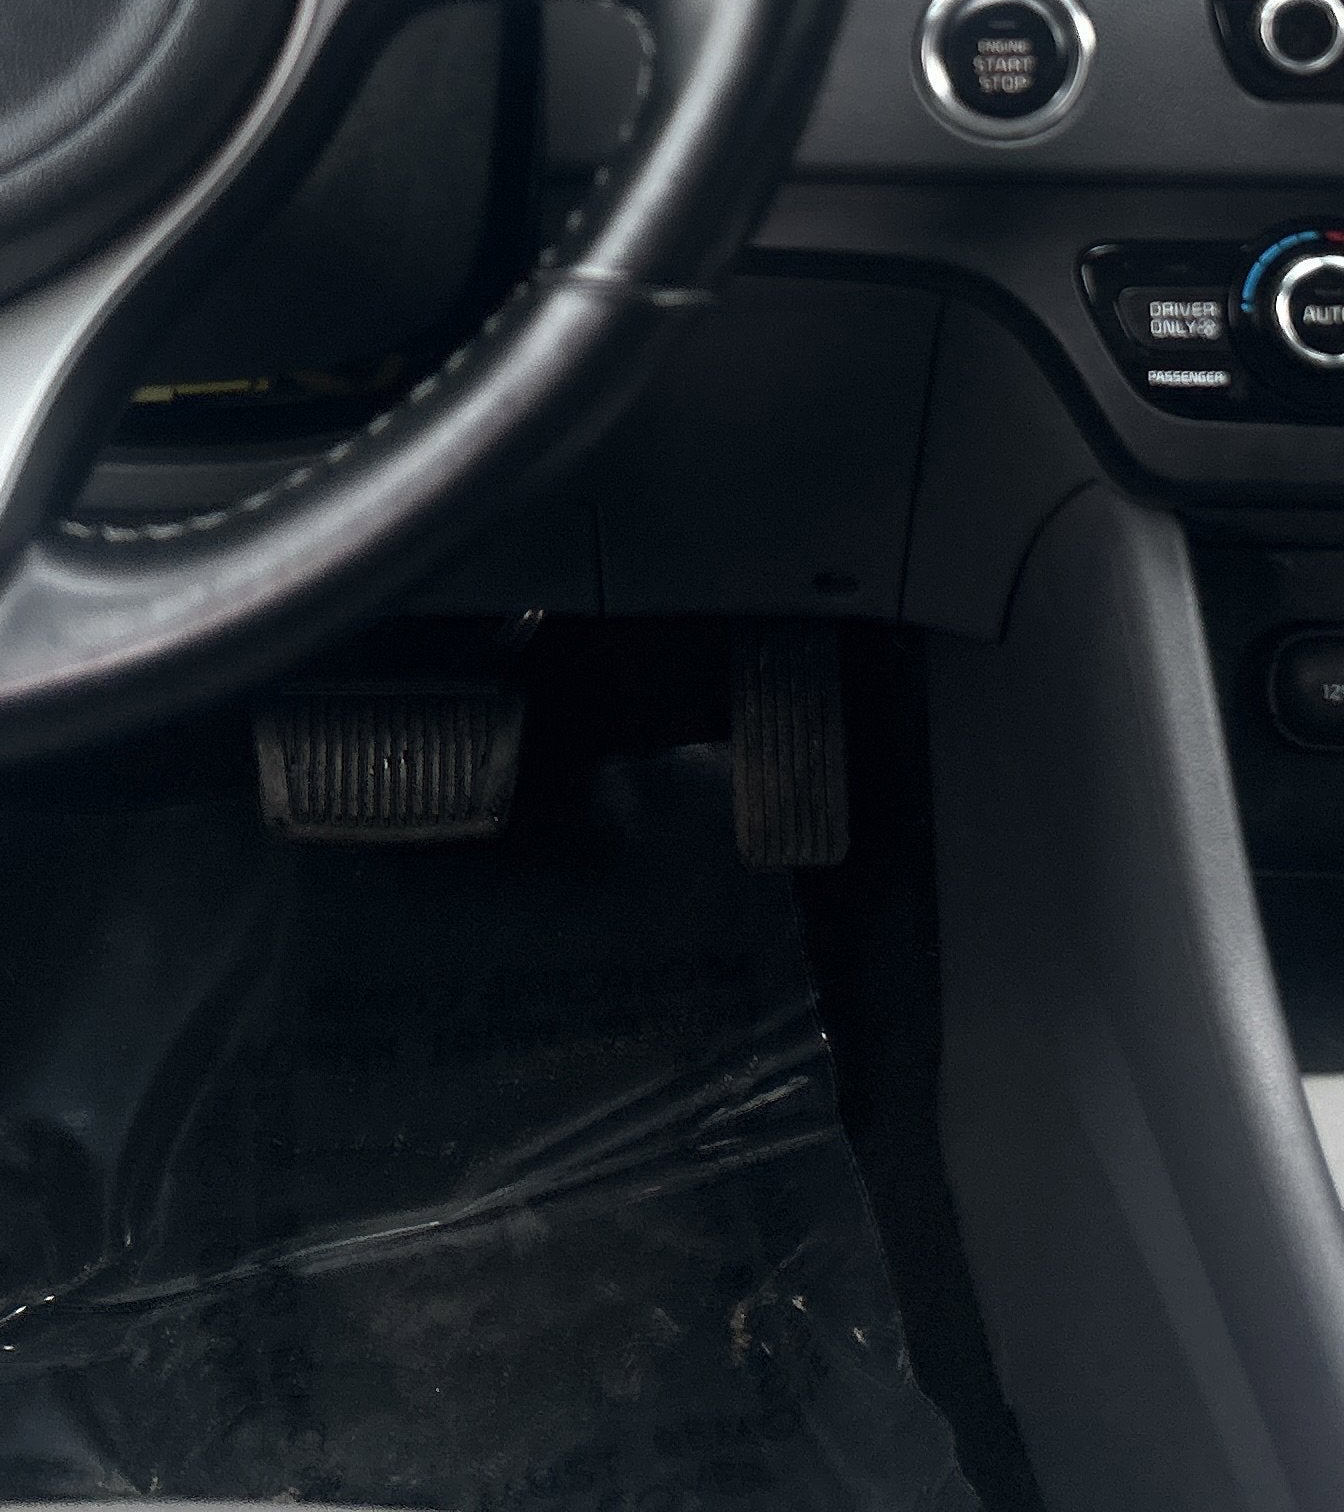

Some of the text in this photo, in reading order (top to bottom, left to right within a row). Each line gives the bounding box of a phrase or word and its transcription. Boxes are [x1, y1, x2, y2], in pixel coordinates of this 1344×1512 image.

[977, 38, 1032, 54] ENGINE
[973, 55, 1038, 74] START
[977, 75, 1035, 94] STOP
[1149, 301, 1218, 319] DRIVER
[1150, 318, 1196, 336] ONLY
[1148, 370, 1231, 387] PASSENGER
